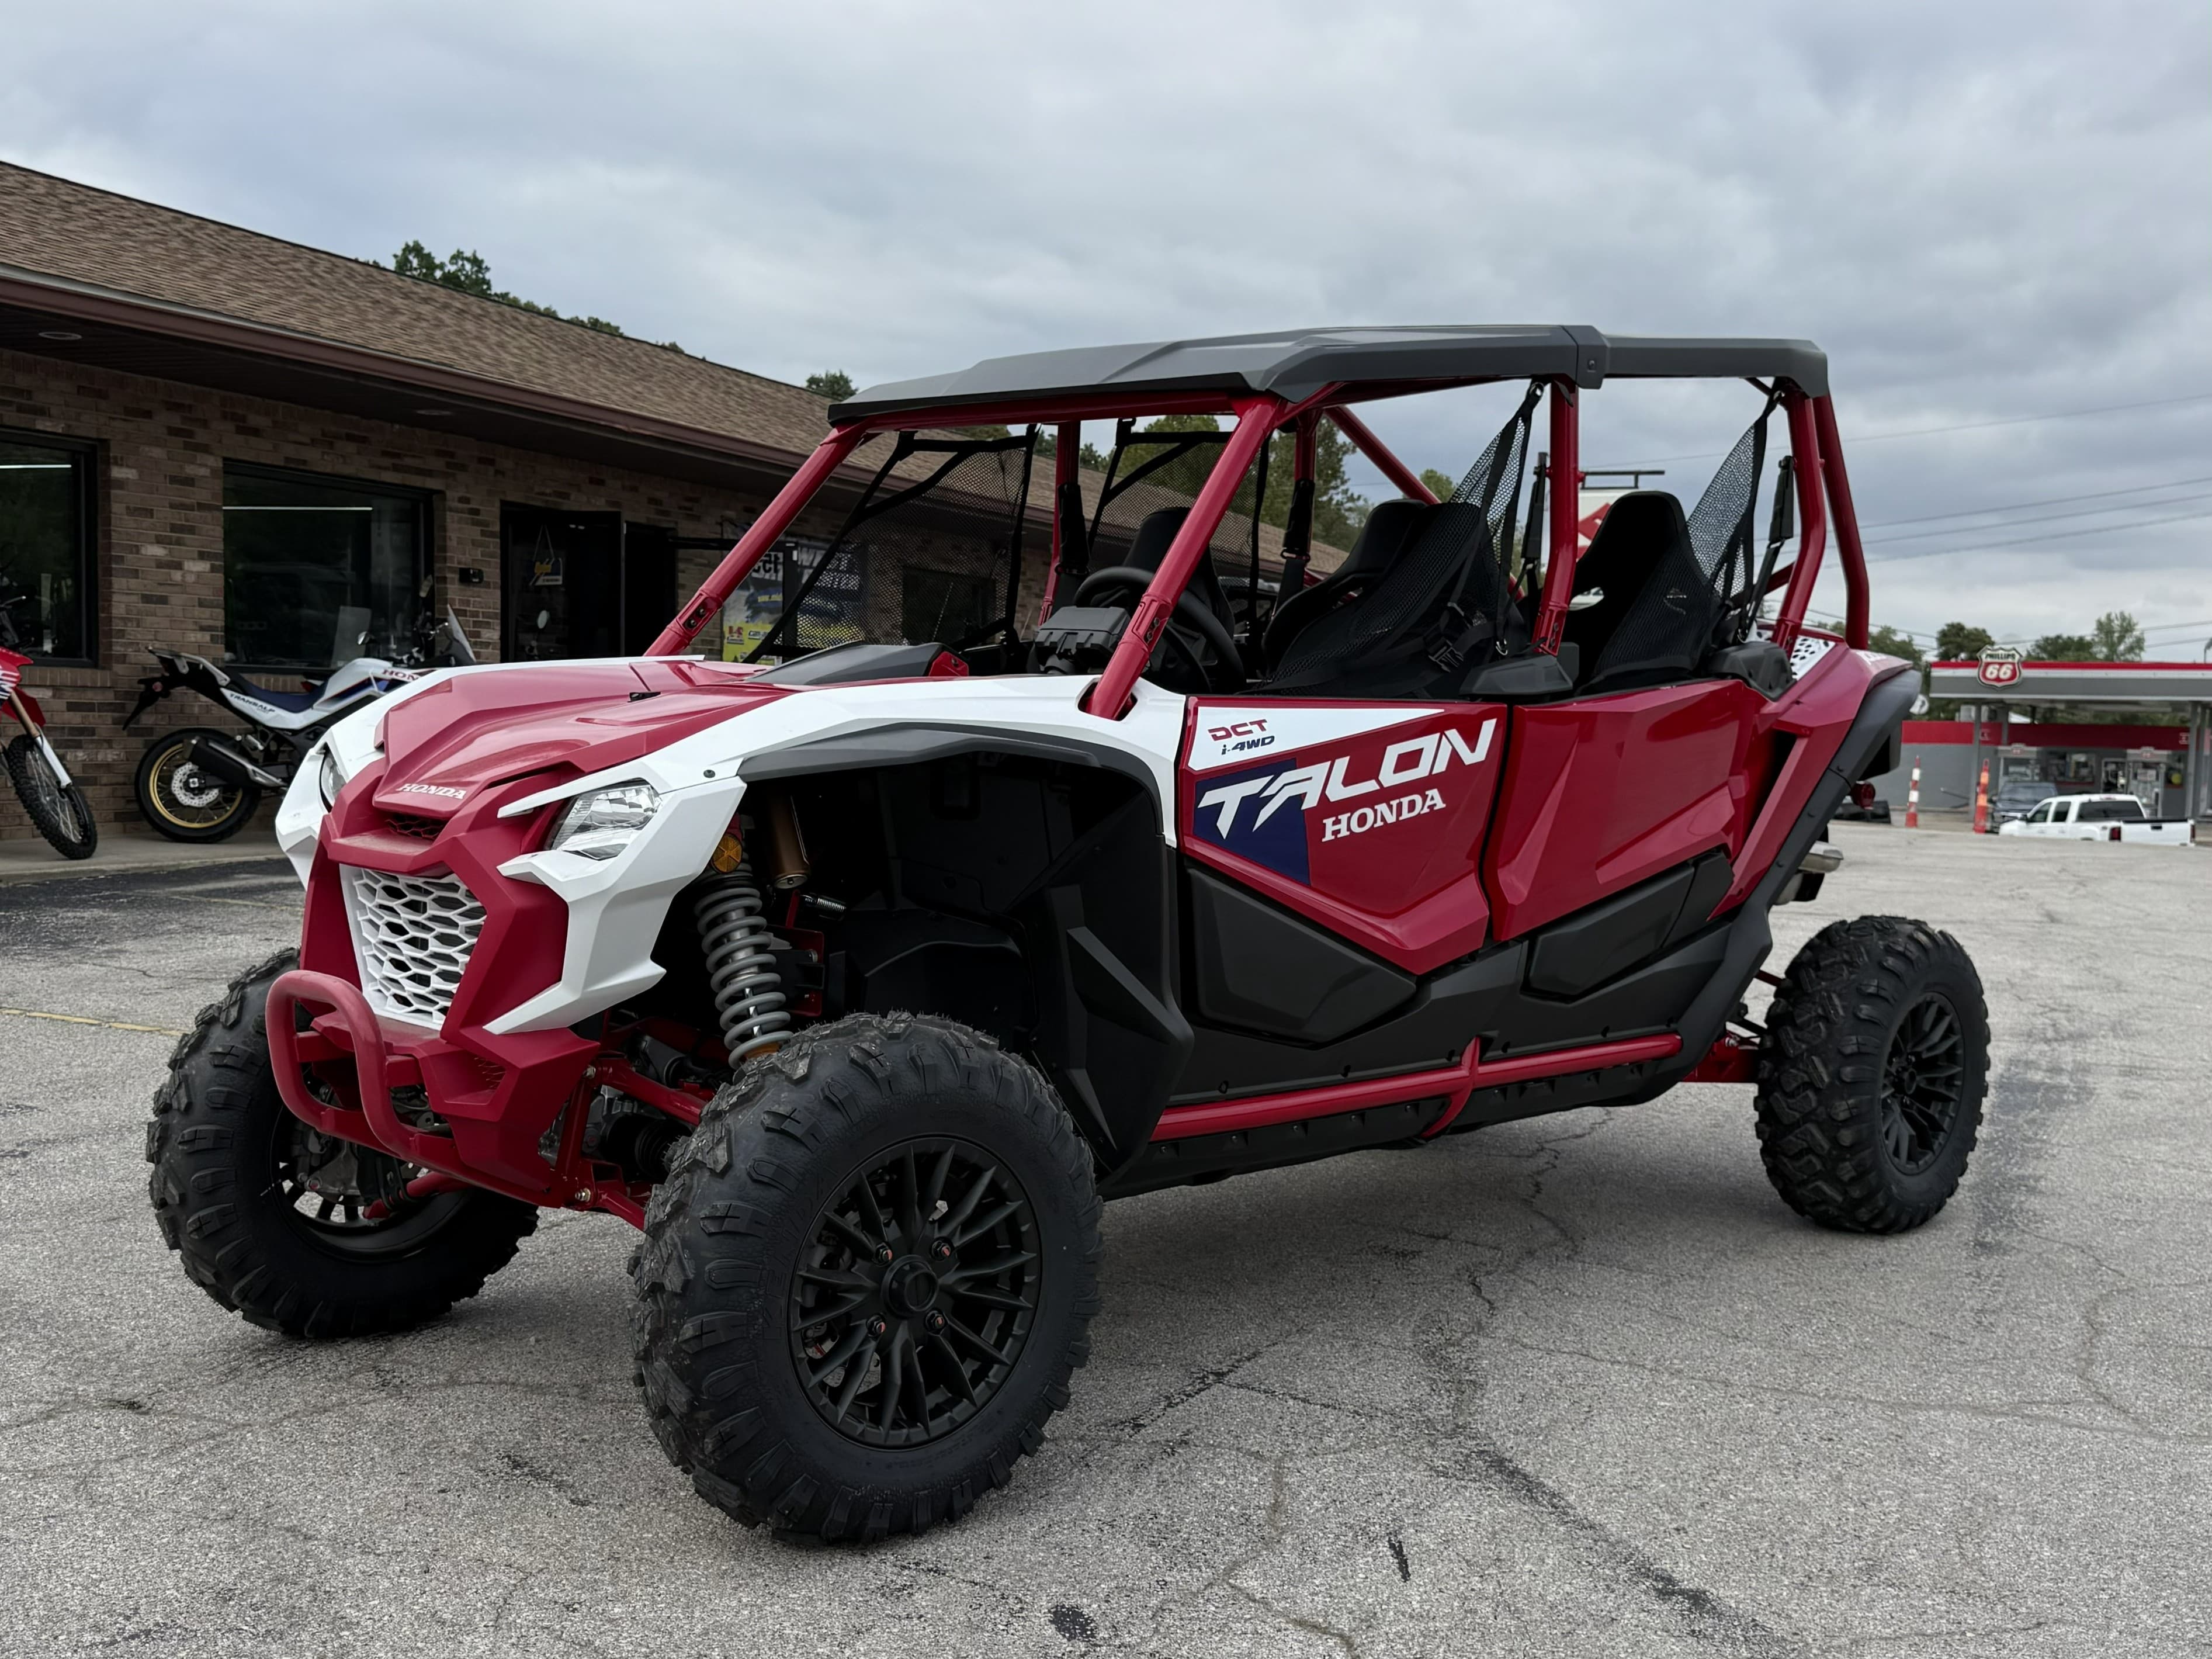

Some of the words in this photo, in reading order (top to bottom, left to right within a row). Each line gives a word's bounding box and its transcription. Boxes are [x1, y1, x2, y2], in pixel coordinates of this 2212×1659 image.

[1985, 664, 2013, 680] 66
[230, 693, 275, 712] TRANSALP
[1208, 719, 1267, 741] DCT
[1221, 735, 1274, 755] i-4WD
[1198, 718, 1497, 839] TALON
[396, 783, 466, 799] HONDA
[1322, 789, 1446, 841] HONDA
